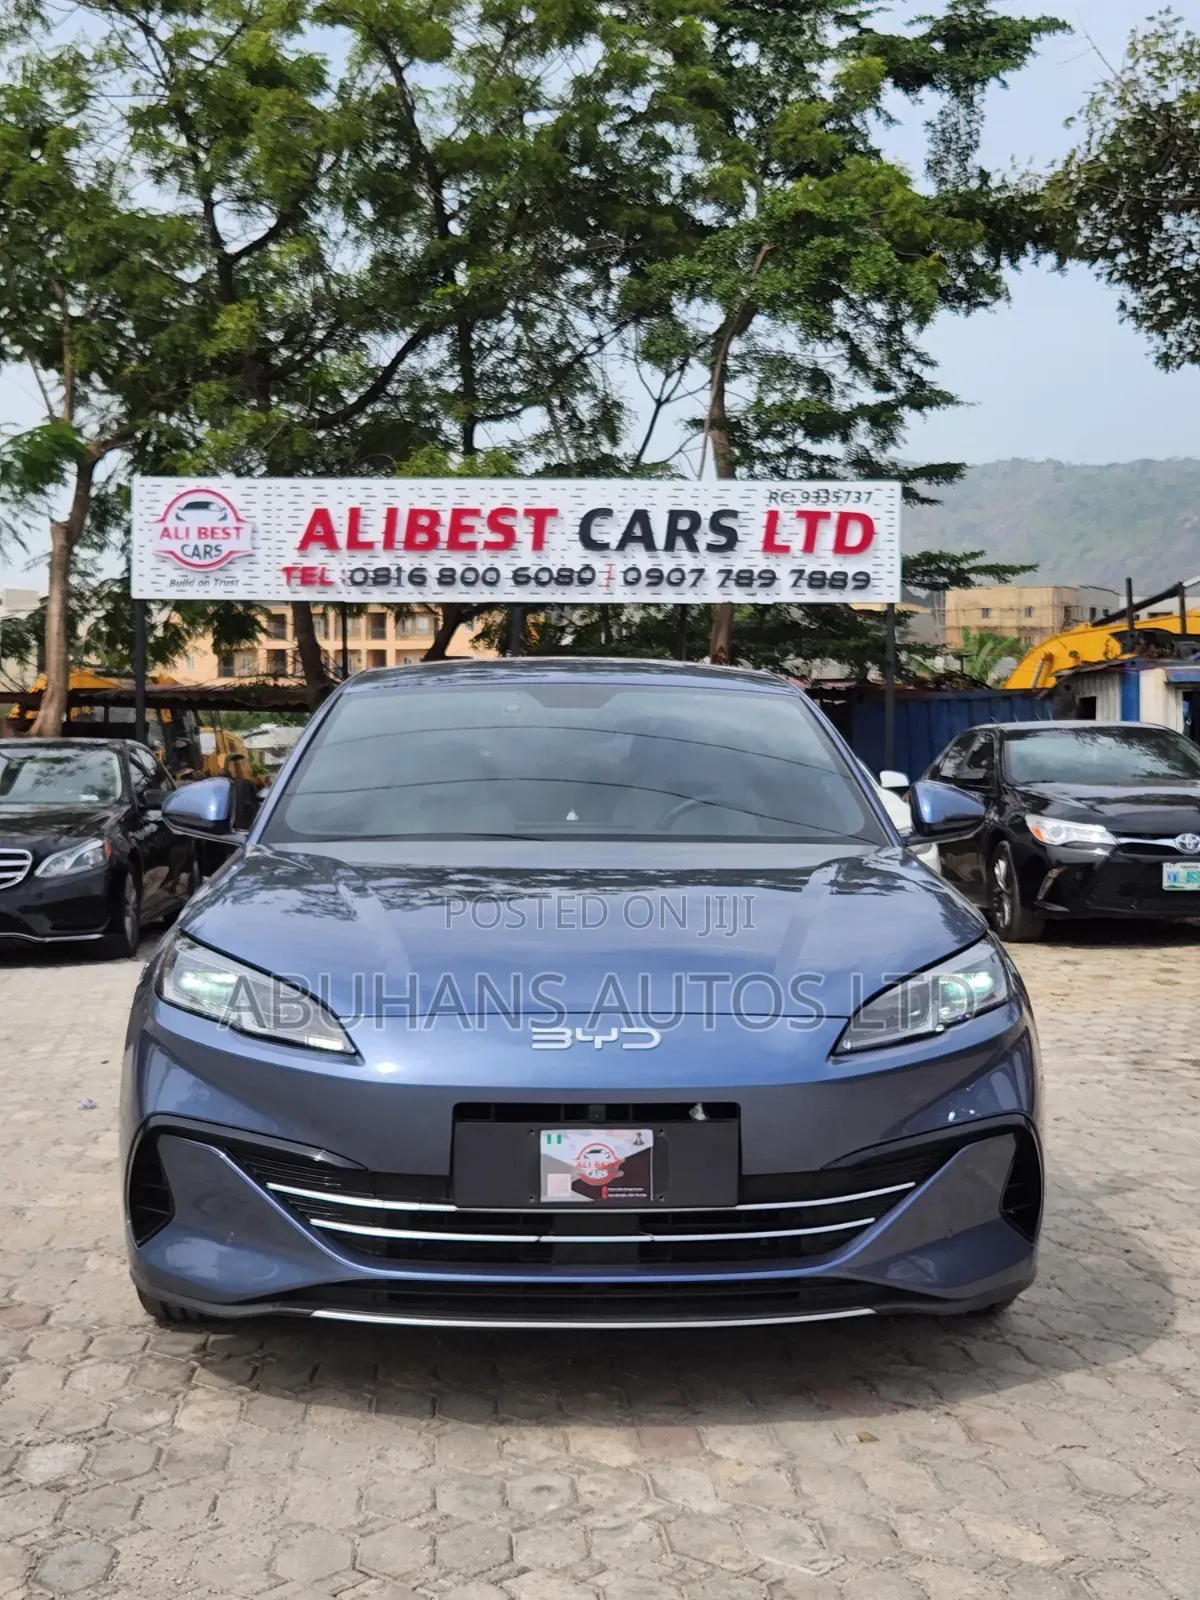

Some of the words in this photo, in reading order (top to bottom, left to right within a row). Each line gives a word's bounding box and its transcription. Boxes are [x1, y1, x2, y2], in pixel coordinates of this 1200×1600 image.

[160, 526, 190, 540] ALI
[197, 526, 244, 540] BEST
[297, 507, 559, 552] ALIBEST
[578, 508, 739, 553] CARS
[761, 509, 876, 555] LTD
[180, 544, 223, 560] CARS
[169, 578, 195, 587] Build
[198, 579, 210, 587] on
[214, 578, 239, 587] Trust
[350, 567, 427, 587] 0816
[436, 567, 501, 587] 800
[511, 567, 597, 587] 6080
[623, 566, 706, 588] 0907
[716, 568, 777, 588] 789
[788, 568, 872, 591] 7889
[531, 1027, 661, 1050] BYD
